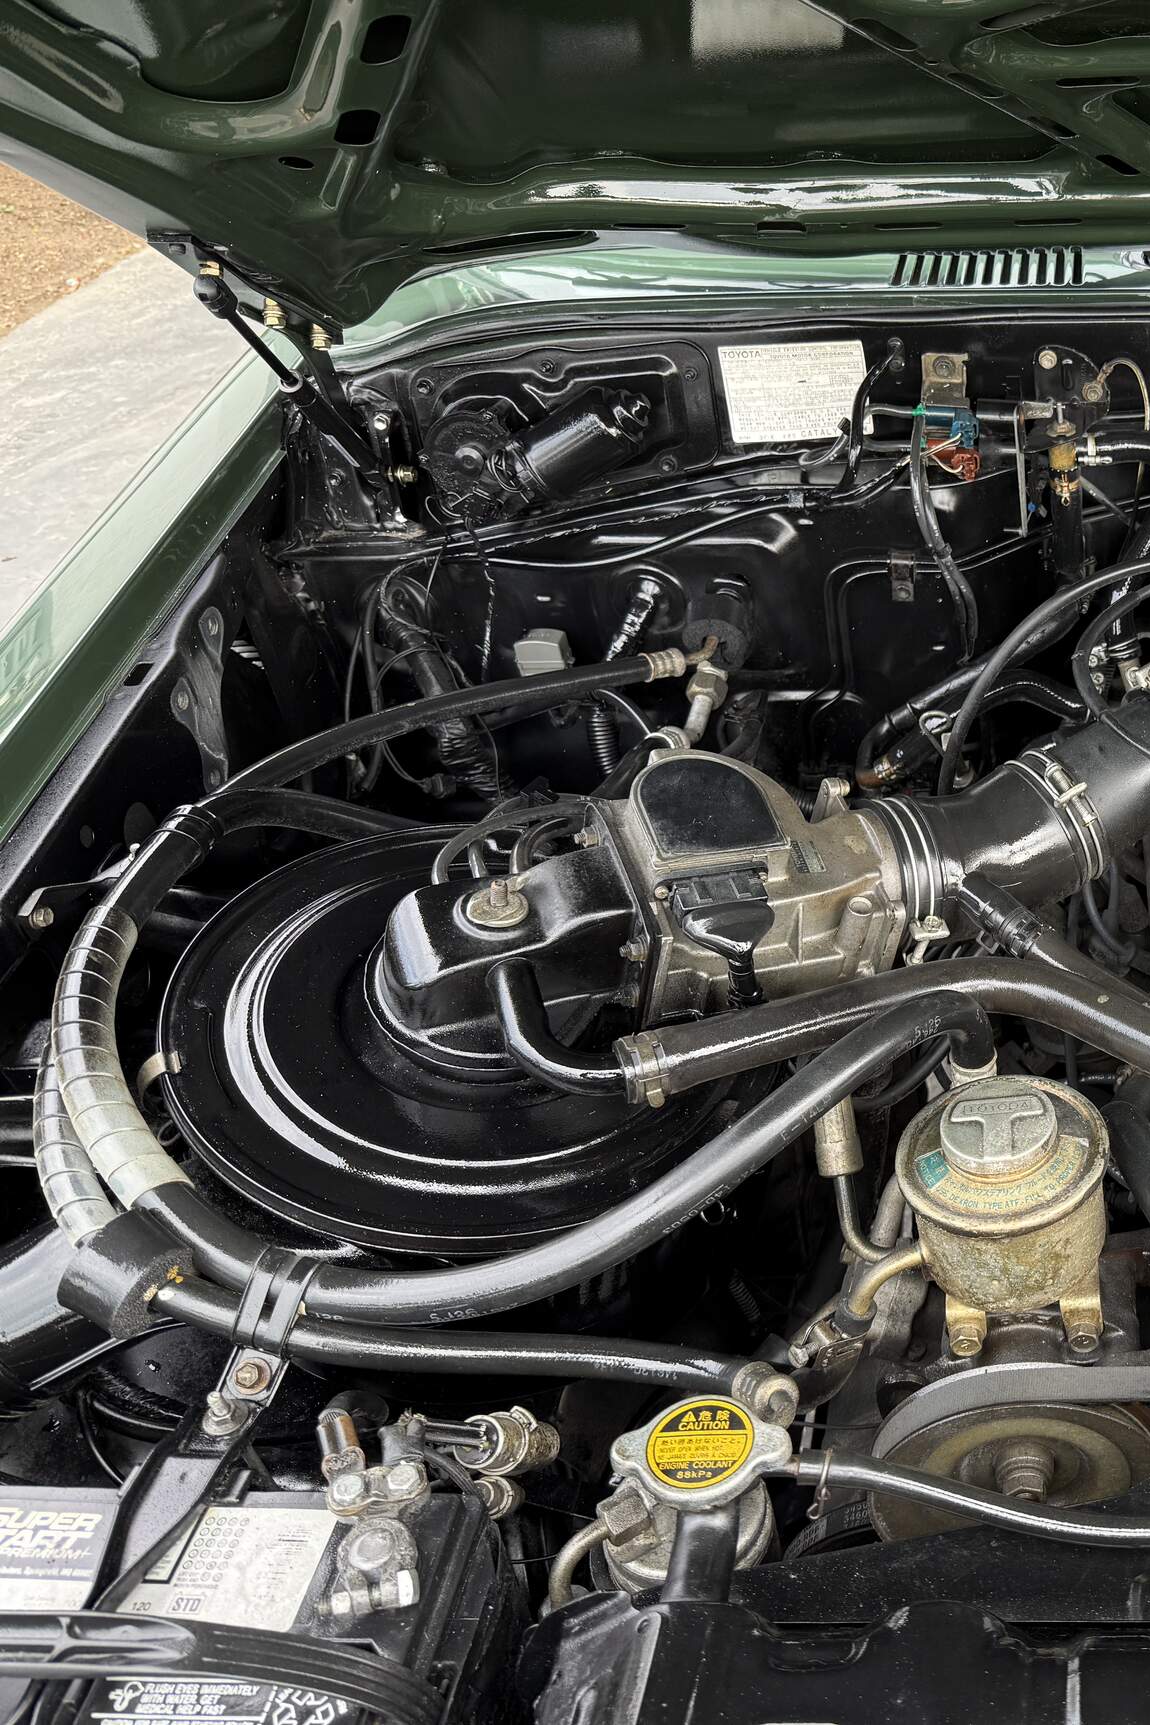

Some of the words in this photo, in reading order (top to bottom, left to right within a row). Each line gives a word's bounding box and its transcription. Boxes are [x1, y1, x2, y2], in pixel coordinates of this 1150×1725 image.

[722, 350, 761, 359] TOYOTA
[982, 1199, 1003, 1210] TYPE
[678, 1421, 730, 1431] CAUTION
[659, 1461, 690, 1470] ENGINE
[692, 1460, 734, 1469] COOLANT
[131, 1600, 152, 1612] 120
[172, 1597, 200, 1612] STD
[143, 1683, 174, 1694] FLUSH
[175, 1684, 199, 1695] EYES
[199, 1684, 261, 1696] IMMEDIATELY
[140, 1694, 167, 1705] WITH
[201, 1695, 222, 1705] GET
[135, 1704, 174, 1715] MEDICAL
[175, 1704, 200, 1715] HELP
[200, 1704, 226, 1715] FAST
